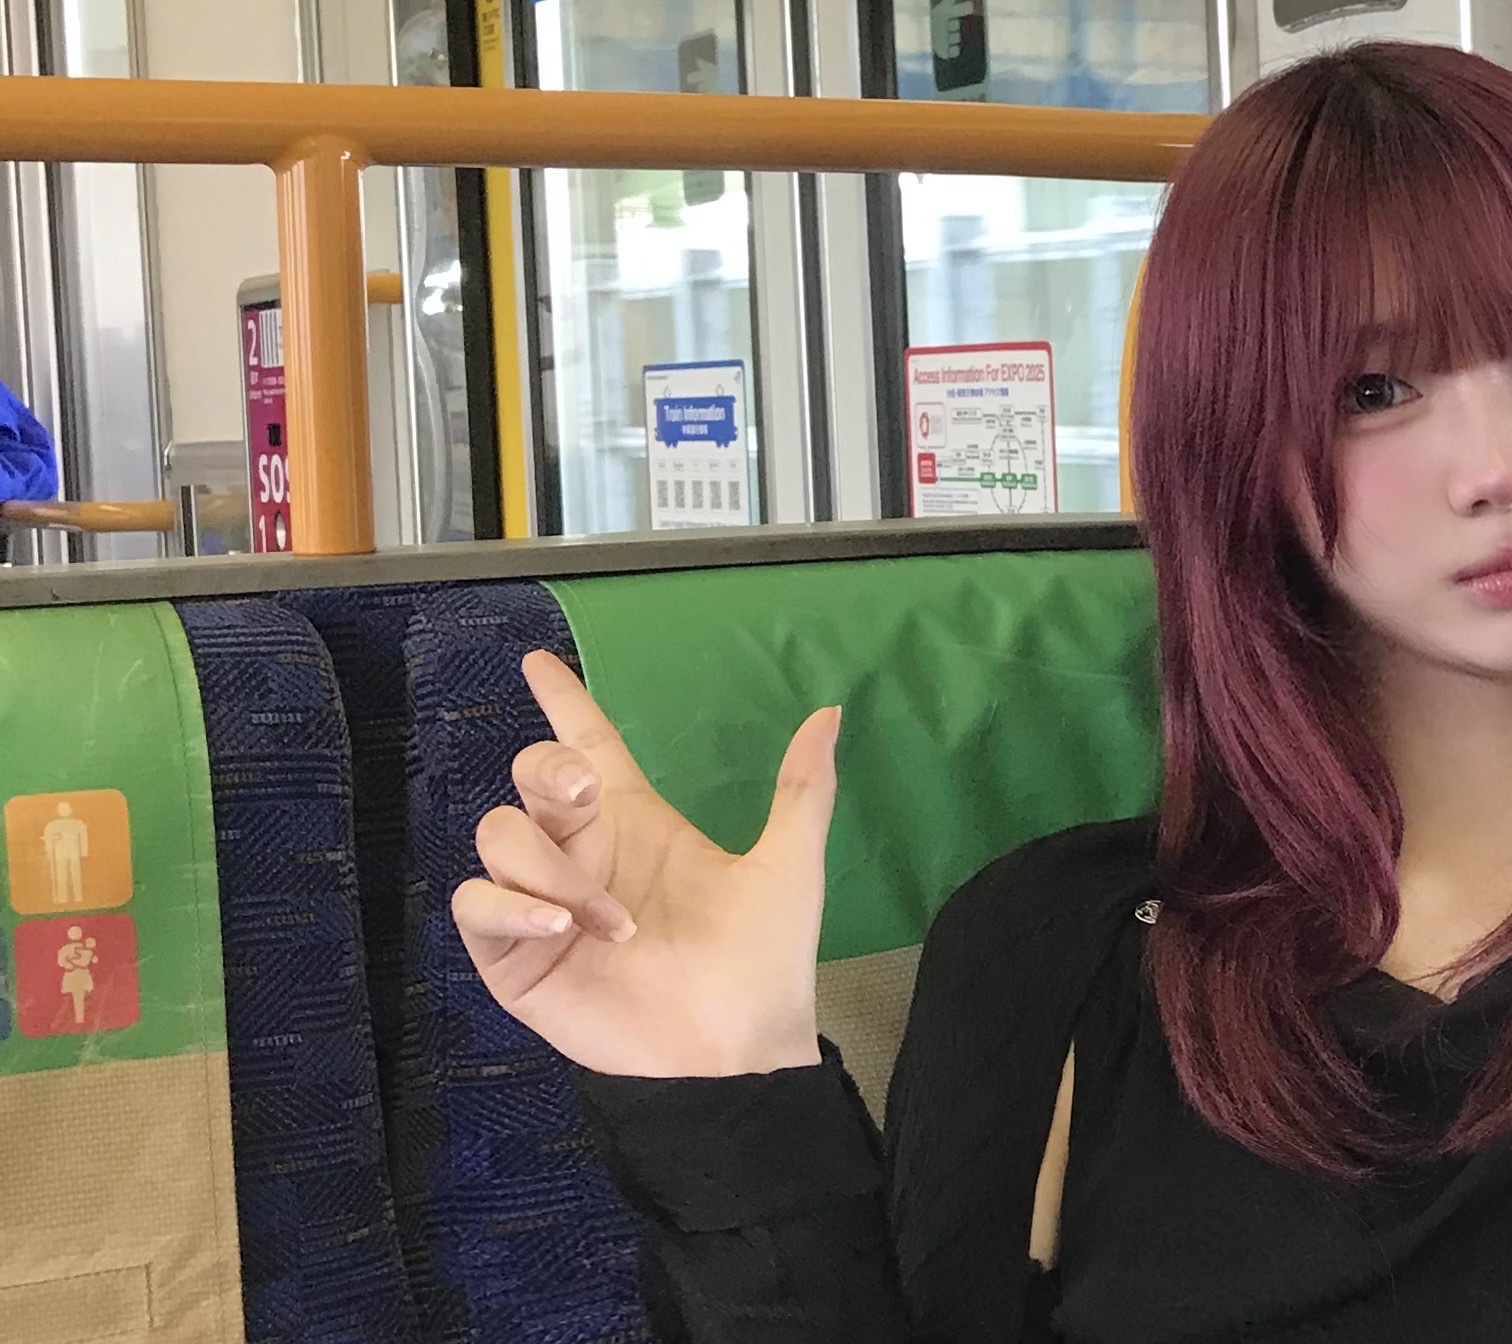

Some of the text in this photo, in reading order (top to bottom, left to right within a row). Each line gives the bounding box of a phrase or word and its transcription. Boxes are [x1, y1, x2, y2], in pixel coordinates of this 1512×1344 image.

[247, 319, 259, 366] 2
[914, 362, 1045, 384] Access Information For EXPO 2025
[258, 453, 291, 503] SO
